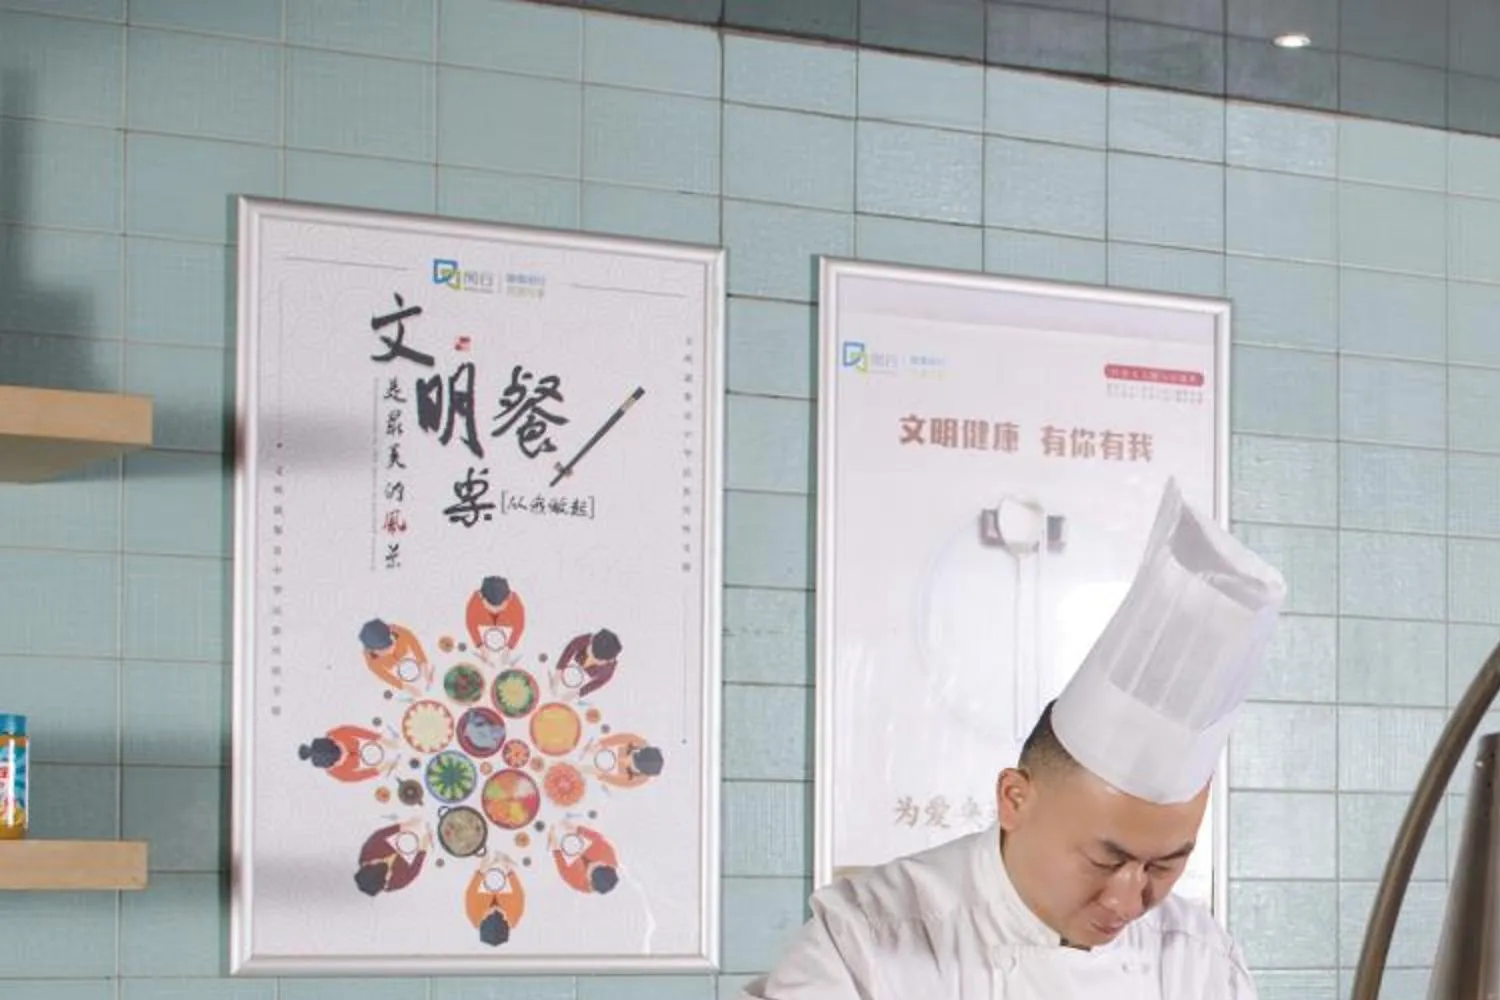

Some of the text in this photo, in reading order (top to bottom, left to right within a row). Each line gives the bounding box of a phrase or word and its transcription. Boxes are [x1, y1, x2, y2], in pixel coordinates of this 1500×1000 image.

[899, 412, 1154, 463] 文明健康 有你有我
